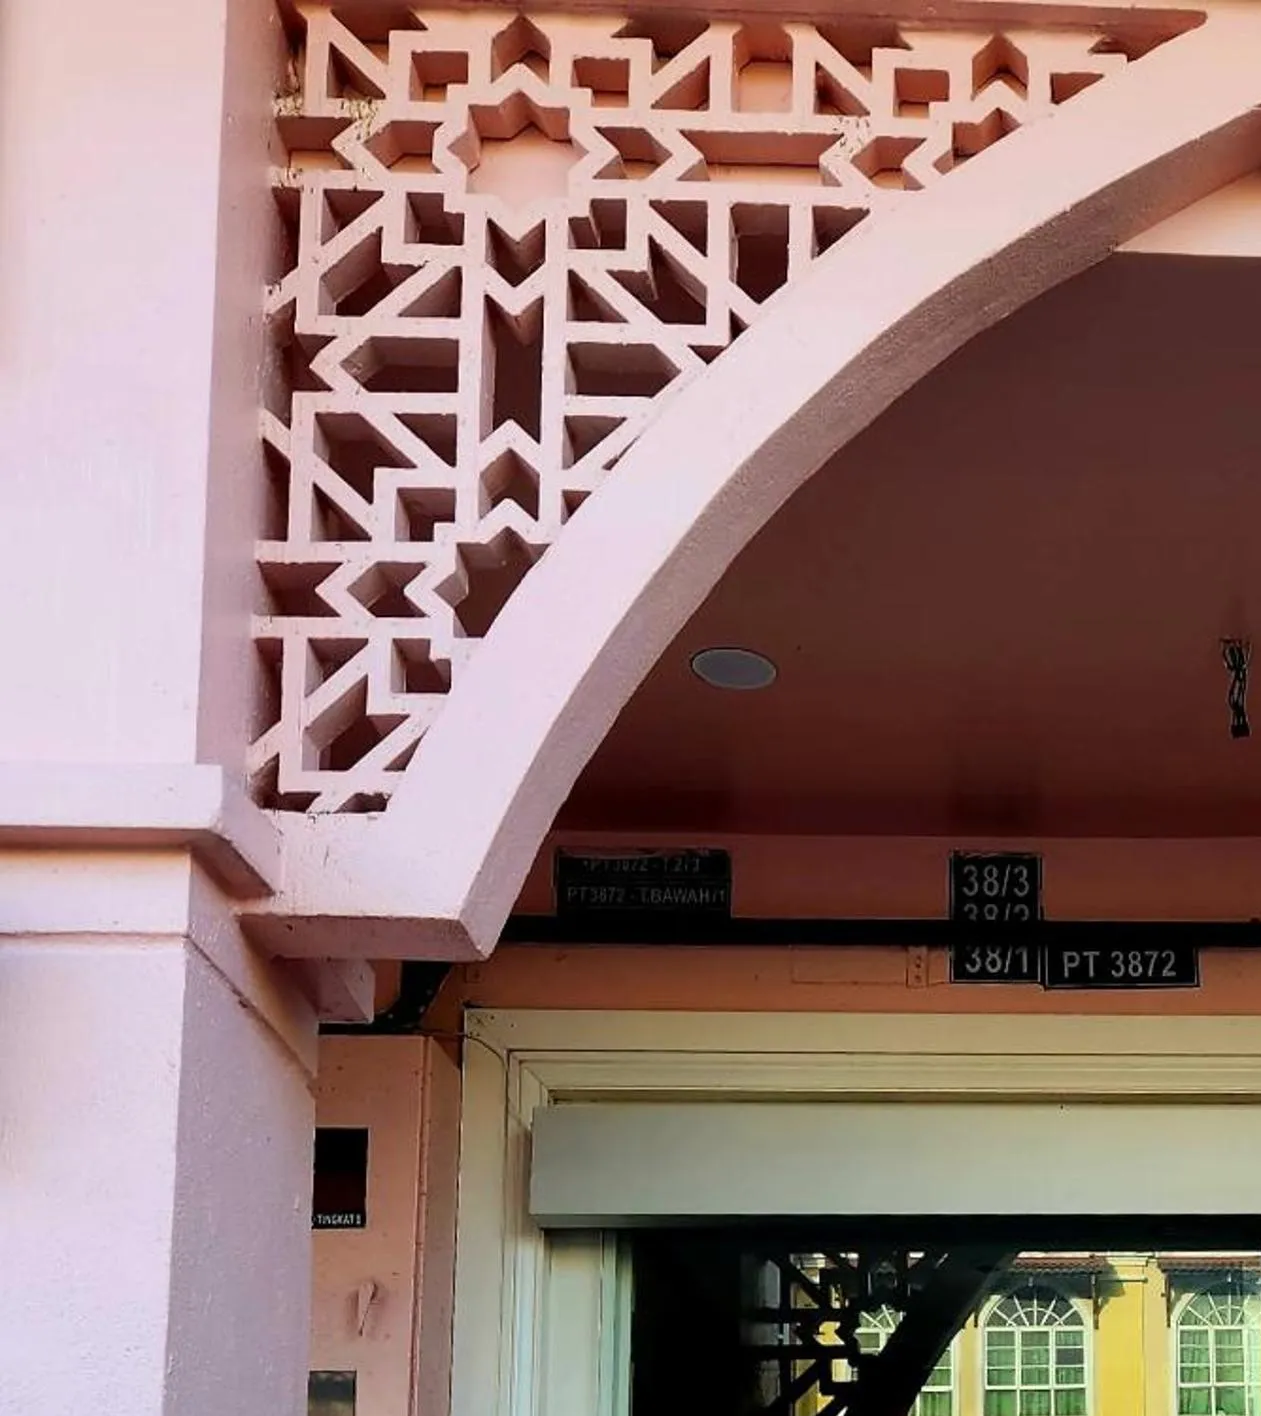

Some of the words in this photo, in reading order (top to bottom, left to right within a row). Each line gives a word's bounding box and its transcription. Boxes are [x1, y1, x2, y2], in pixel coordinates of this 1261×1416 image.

[962, 864, 1030, 897] 38/3
[965, 945, 1028, 974] 38/1
[1063, 951, 1100, 978] PT
[1111, 950, 1177, 978] 3872
